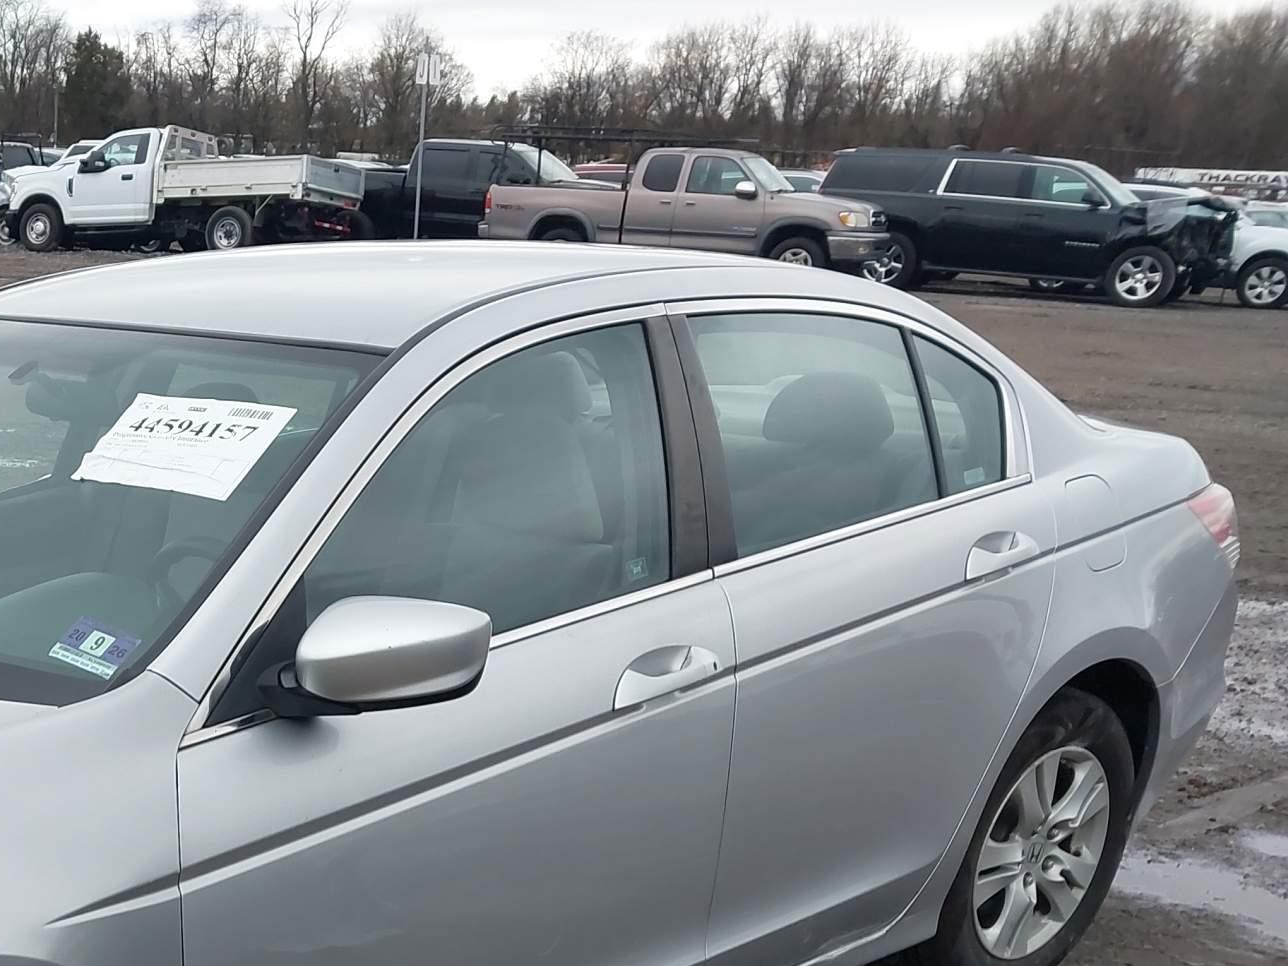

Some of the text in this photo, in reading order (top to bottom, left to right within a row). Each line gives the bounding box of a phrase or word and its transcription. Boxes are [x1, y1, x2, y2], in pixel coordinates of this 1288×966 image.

[129, 416, 259, 441] 44594157
[89, 636, 106, 651] 9
[107, 645, 128, 658] 26
